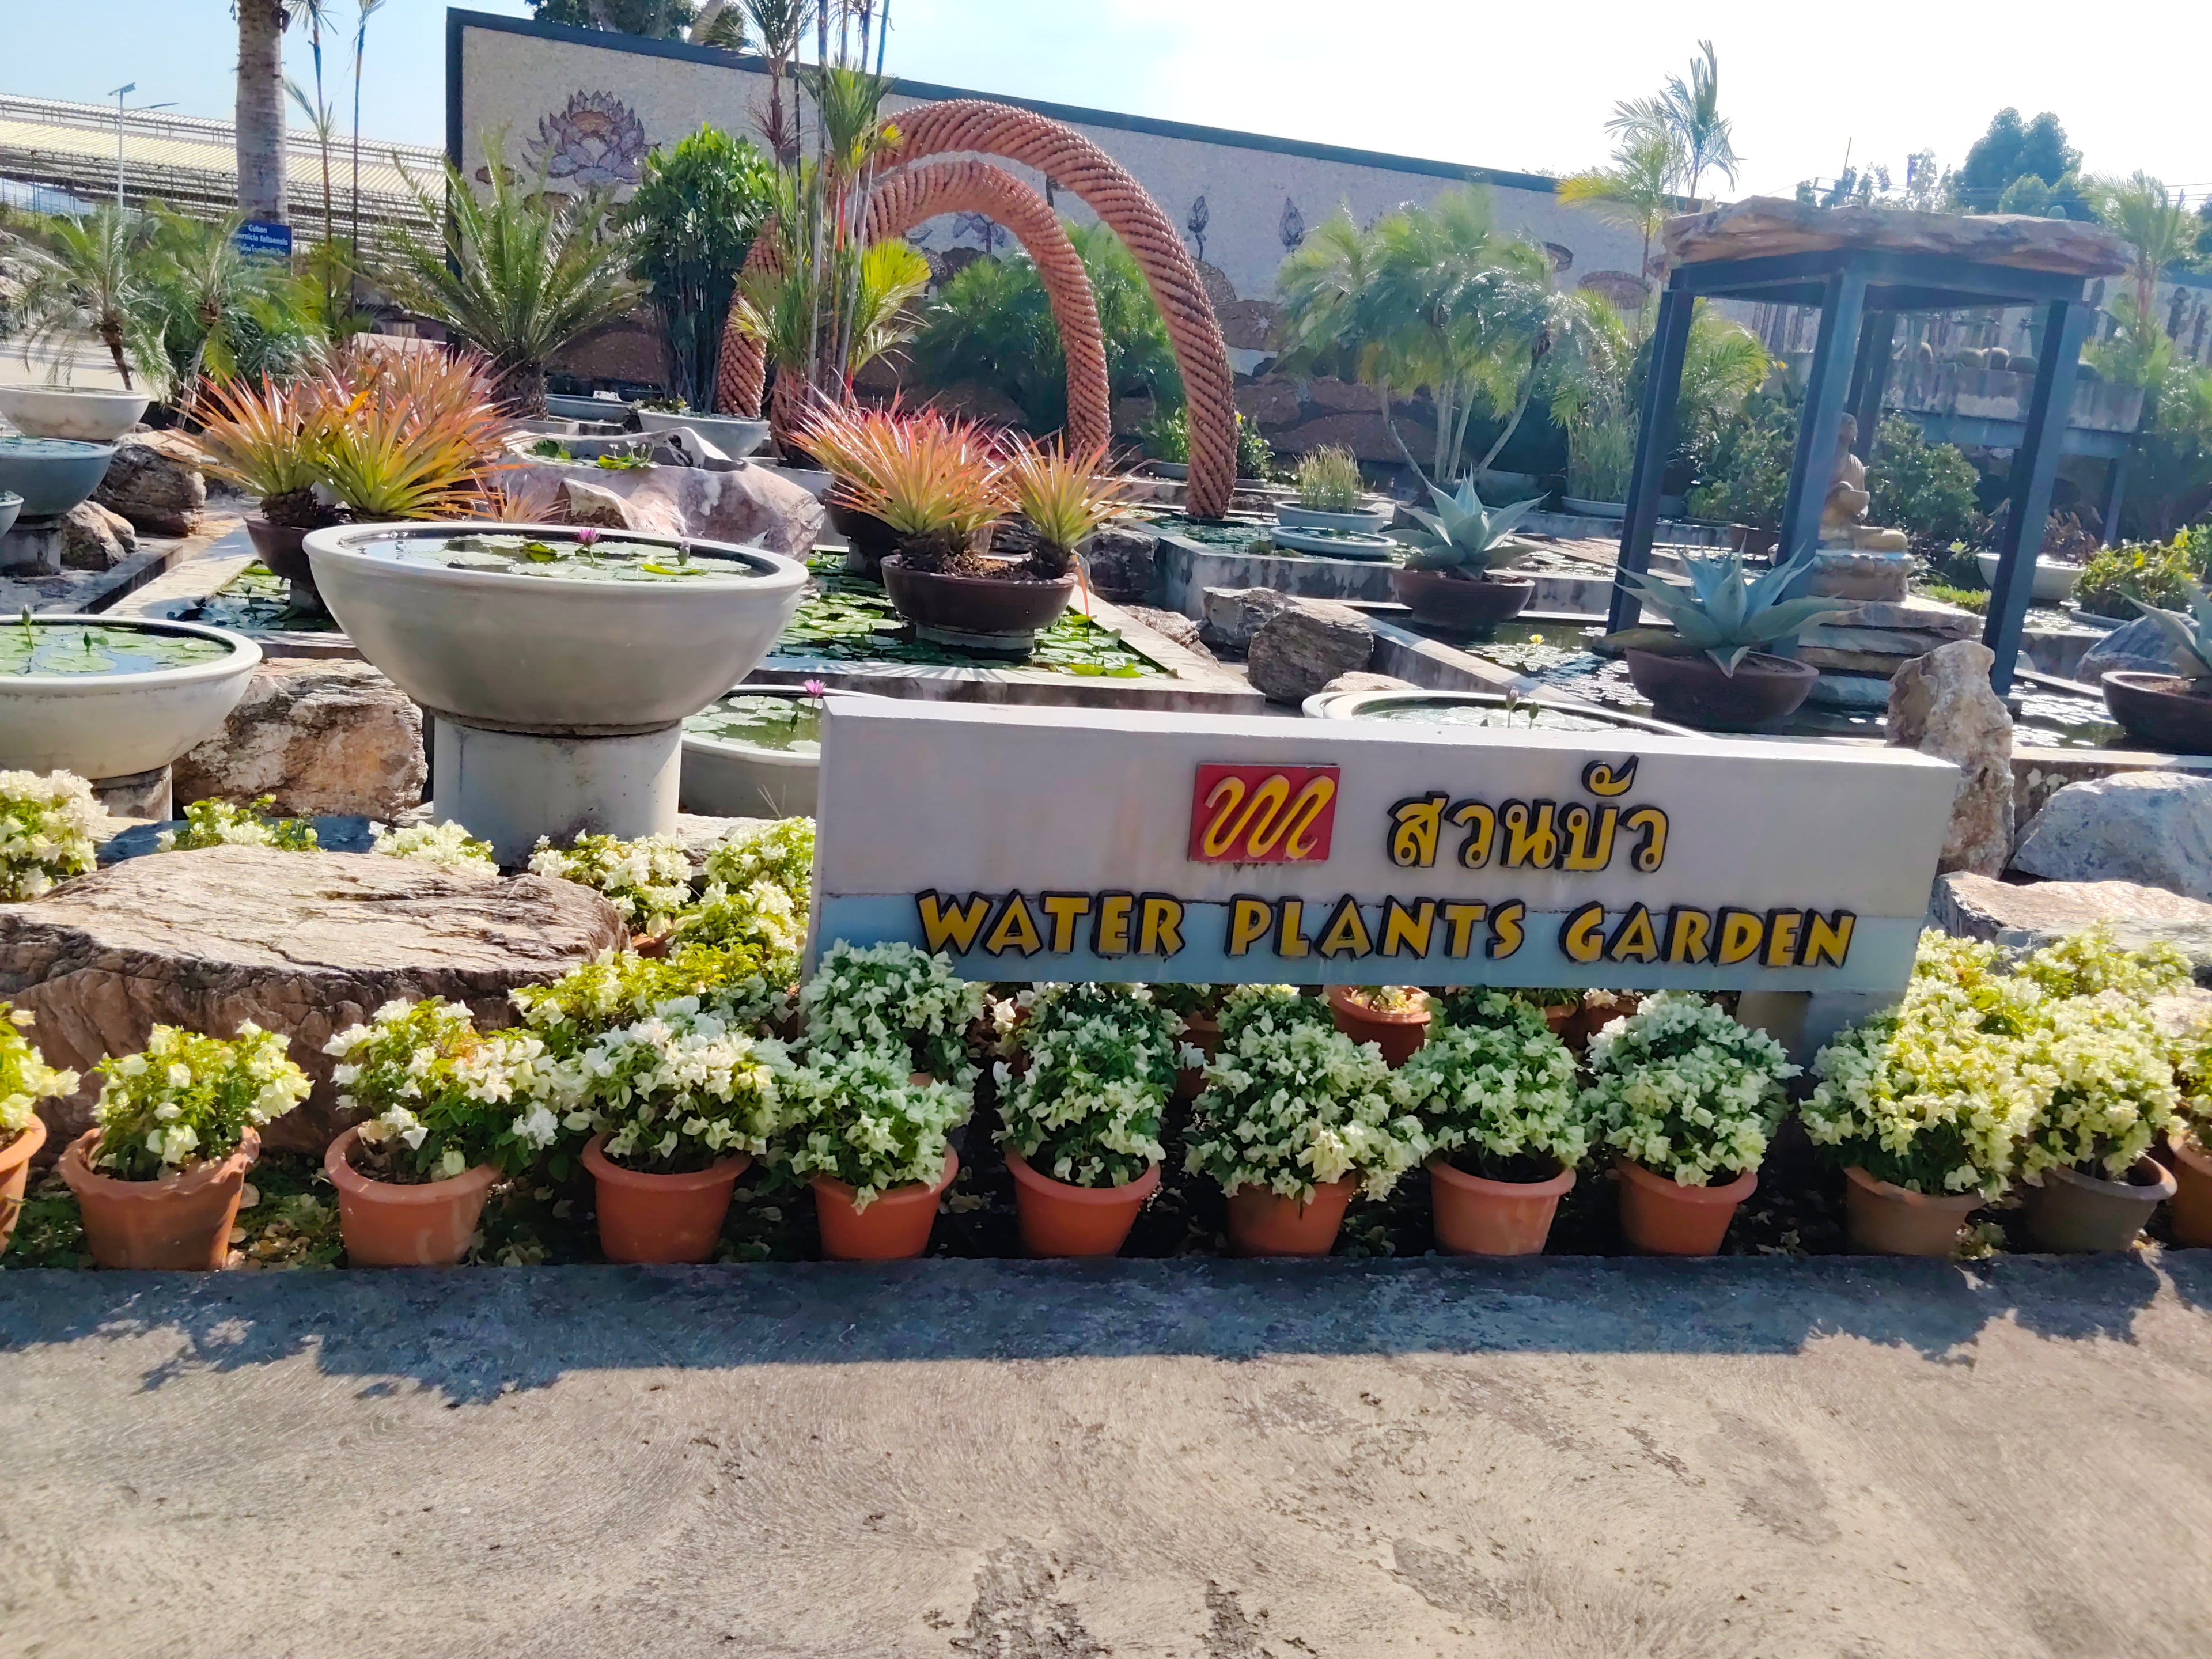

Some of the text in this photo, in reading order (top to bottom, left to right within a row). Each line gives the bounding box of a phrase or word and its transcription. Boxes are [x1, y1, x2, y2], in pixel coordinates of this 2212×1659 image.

[248, 224, 267, 233] Cuban
[1387, 754, 1669, 873] สวนบัว
[915, 888, 1857, 968] WATER PLANTS GARDEN
